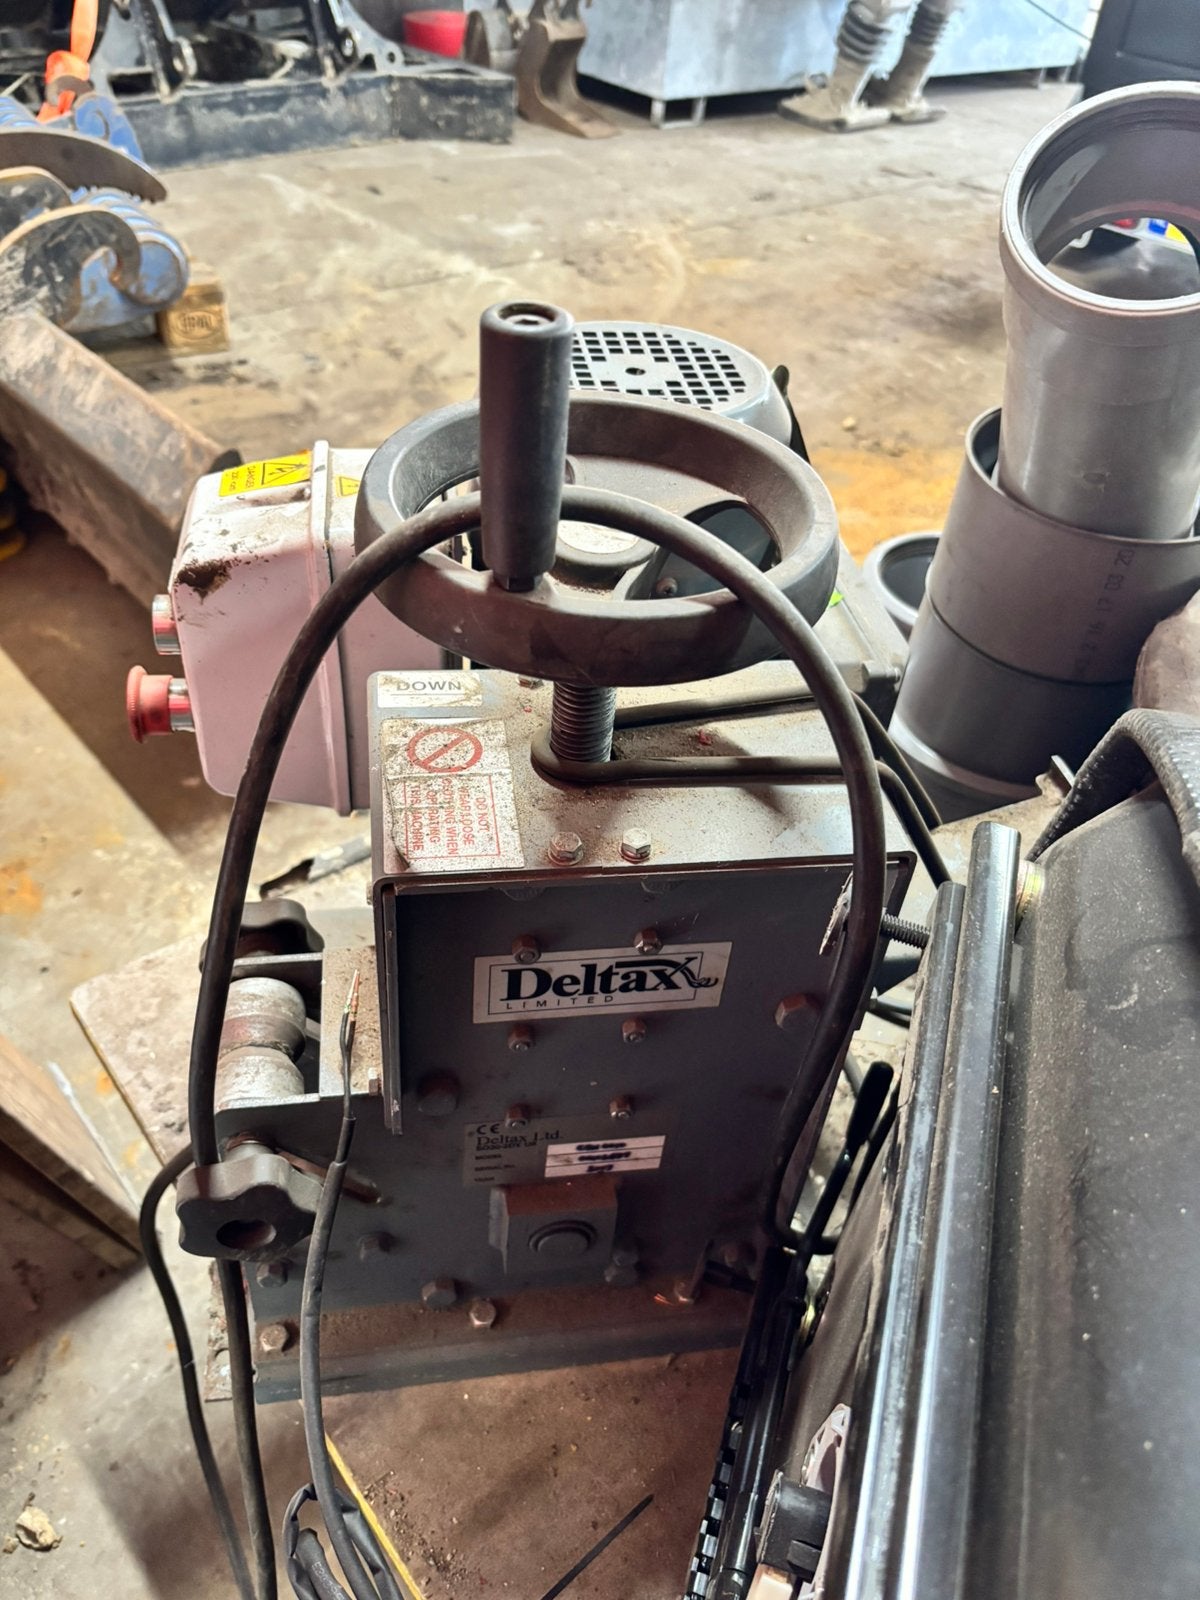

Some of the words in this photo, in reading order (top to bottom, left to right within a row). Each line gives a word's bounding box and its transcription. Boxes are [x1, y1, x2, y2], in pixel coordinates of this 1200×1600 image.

[396, 680, 462, 692] DOWN
[410, 785, 422, 805] THIS
[460, 786, 472, 814] WEAR
[475, 797, 488, 811] DO
[461, 813, 475, 846] LOOSE
[477, 812, 490, 832] NOT
[446, 826, 459, 855] WHEN
[499, 957, 698, 1002] Deltax
[506, 994, 614, 1010] LIMITED
